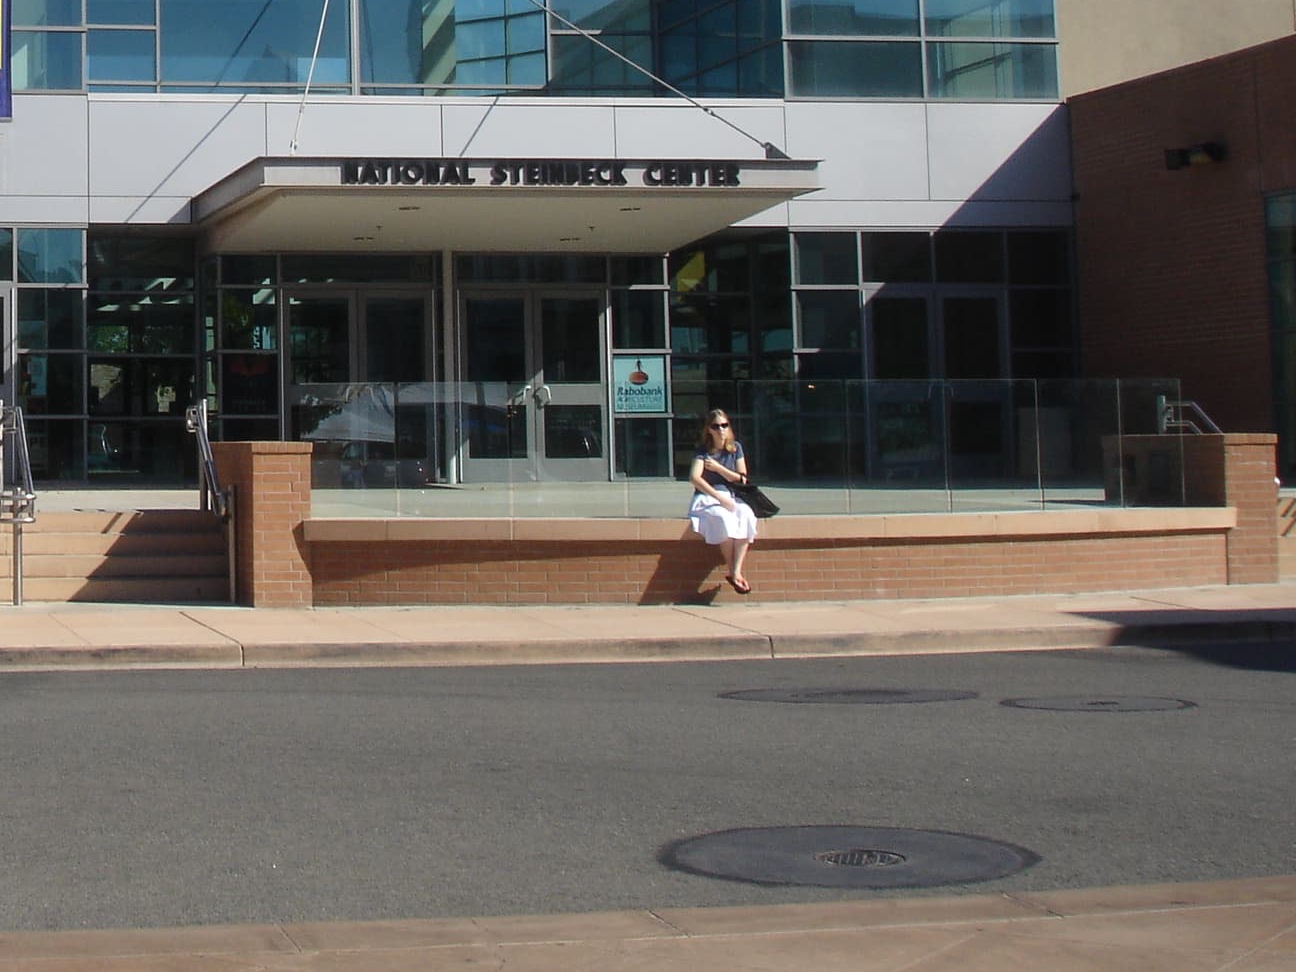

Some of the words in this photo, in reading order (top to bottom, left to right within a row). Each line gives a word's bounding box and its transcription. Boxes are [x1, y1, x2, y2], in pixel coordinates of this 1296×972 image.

[340, 161, 476, 185] NATIONAL
[489, 161, 628, 186] STEINBECK
[642, 161, 741, 187] CENTER
[616, 386, 663, 396] Rabobank
